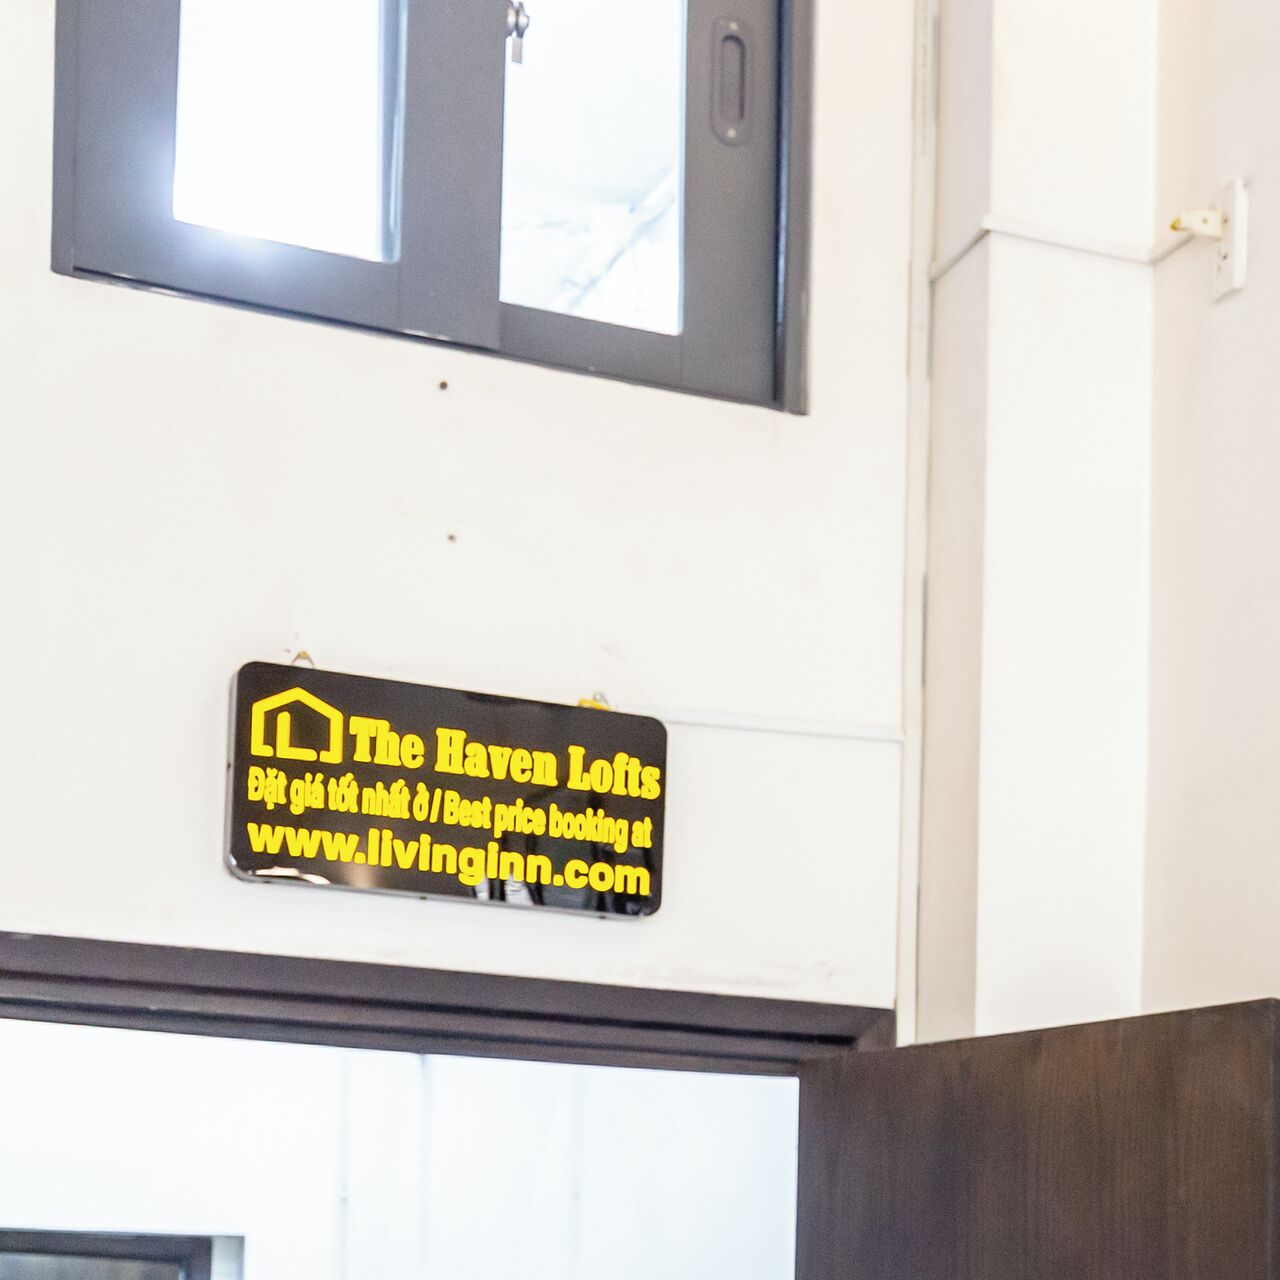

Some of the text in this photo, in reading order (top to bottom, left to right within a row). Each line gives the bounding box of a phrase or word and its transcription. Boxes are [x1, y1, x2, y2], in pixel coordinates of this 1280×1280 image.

[348, 716, 661, 800] The Haven Lofts
[247, 766, 653, 853] Đặt giá tốt nhất ở / Best price booking at
[247, 822, 652, 896] www.livinginn.com
